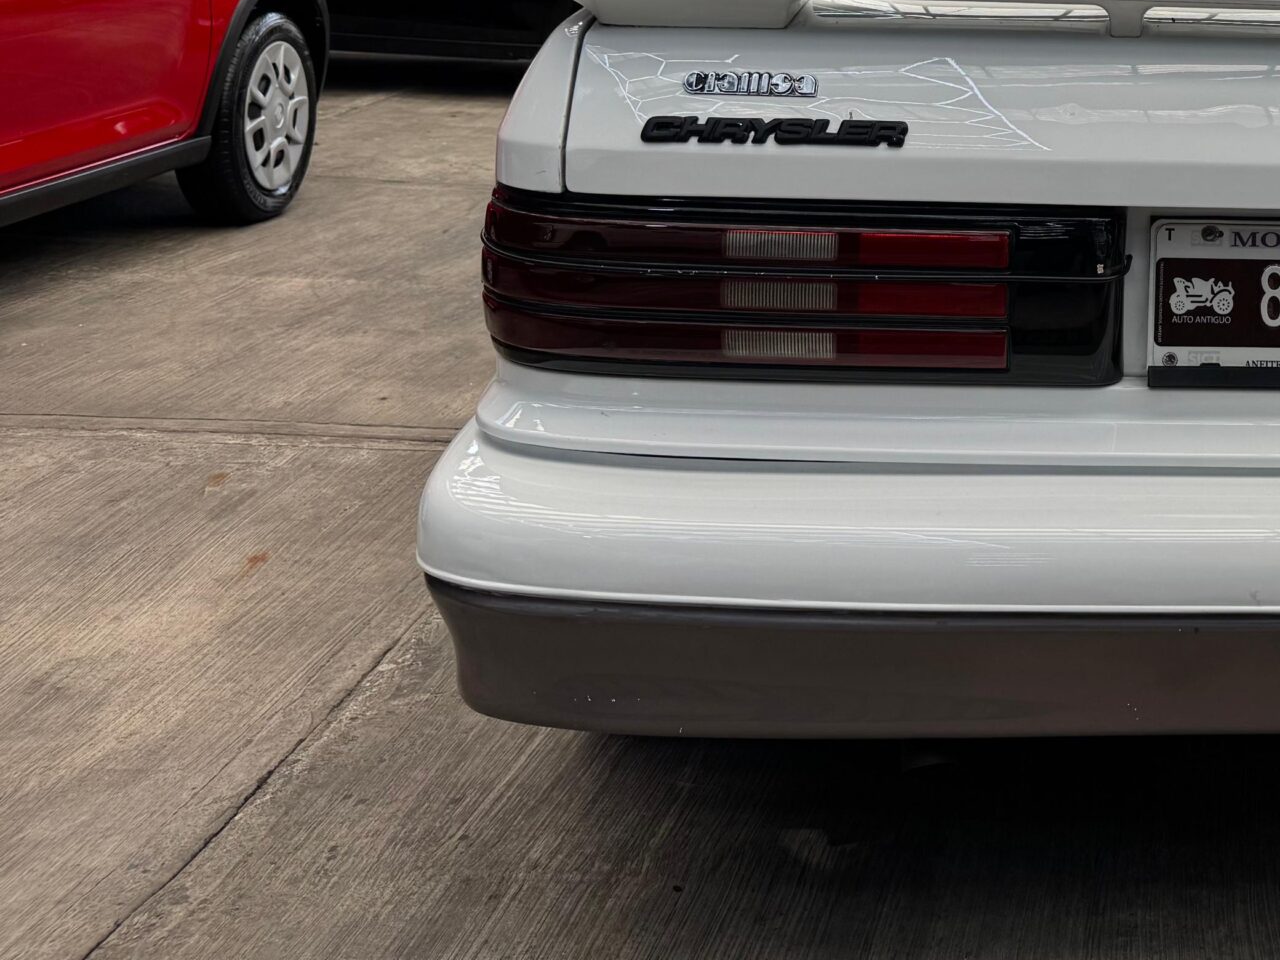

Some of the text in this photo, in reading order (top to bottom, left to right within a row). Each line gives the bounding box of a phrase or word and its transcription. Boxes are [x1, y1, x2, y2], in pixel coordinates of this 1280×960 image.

[640, 115, 909, 149] CHRYSLER
[1165, 228, 1175, 241] T
[1171, 315, 1232, 325] AUTO ANTIGUO
